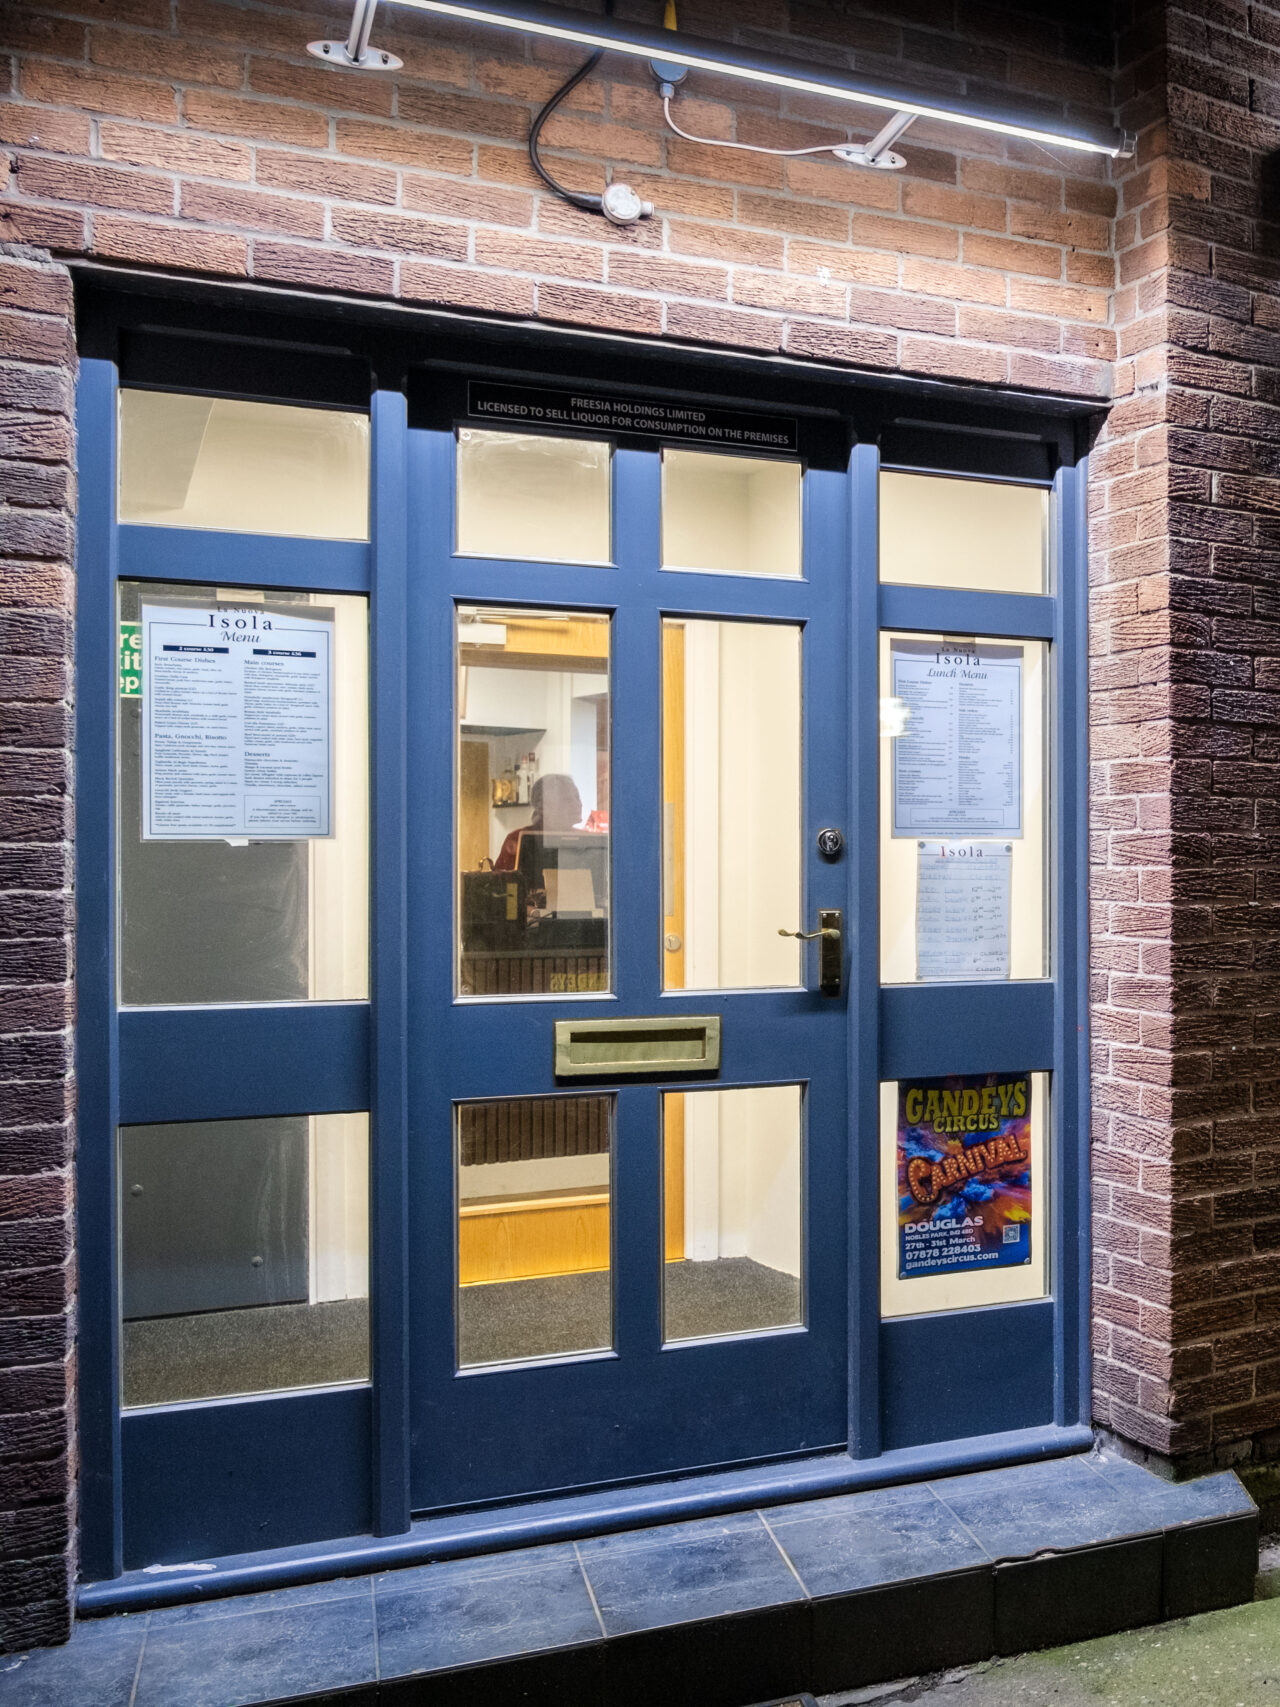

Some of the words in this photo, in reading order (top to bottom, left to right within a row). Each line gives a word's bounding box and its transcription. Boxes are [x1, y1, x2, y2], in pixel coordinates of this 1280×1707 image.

[571, 397, 611, 411] FREESIA
[613, 400, 665, 417] HOLDINGS
[667, 409, 706, 421] LIMITED
[478, 401, 528, 415] LICENSED
[529, 406, 544, 417] TO
[546, 408, 569, 420] SELL
[571, 411, 610, 424] LIQUOR
[612, 416, 632, 426] FOR
[634, 418, 706, 435] CONSUMPTION
[708, 426, 723, 437] ON
[723, 428, 742, 440] THE
[744, 431, 789, 444] PREMISES
[208, 614, 273, 631] Isola
[221, 631, 260, 643] Menu
[936, 653, 981, 666] Isola
[927, 667, 957, 678] Lunch
[960, 669, 988, 680] Menu
[940, 846, 984, 857] Isola
[905, 1081, 1027, 1124] GANDEYS
[933, 1113, 999, 1133] CIRCUS
[907, 1134, 1027, 1203] CARNIVAL
[905, 1216, 984, 1233] DOUGLAS
[905, 1233, 930, 1241] NOBLES
[905, 1242, 925, 1250] 27th
[949, 1236, 976, 1245] March
[906, 1249, 940, 1260] 07878
[942, 1244, 981, 1256] 228403
[905, 1252, 999, 1270] gandeyscircus.com
